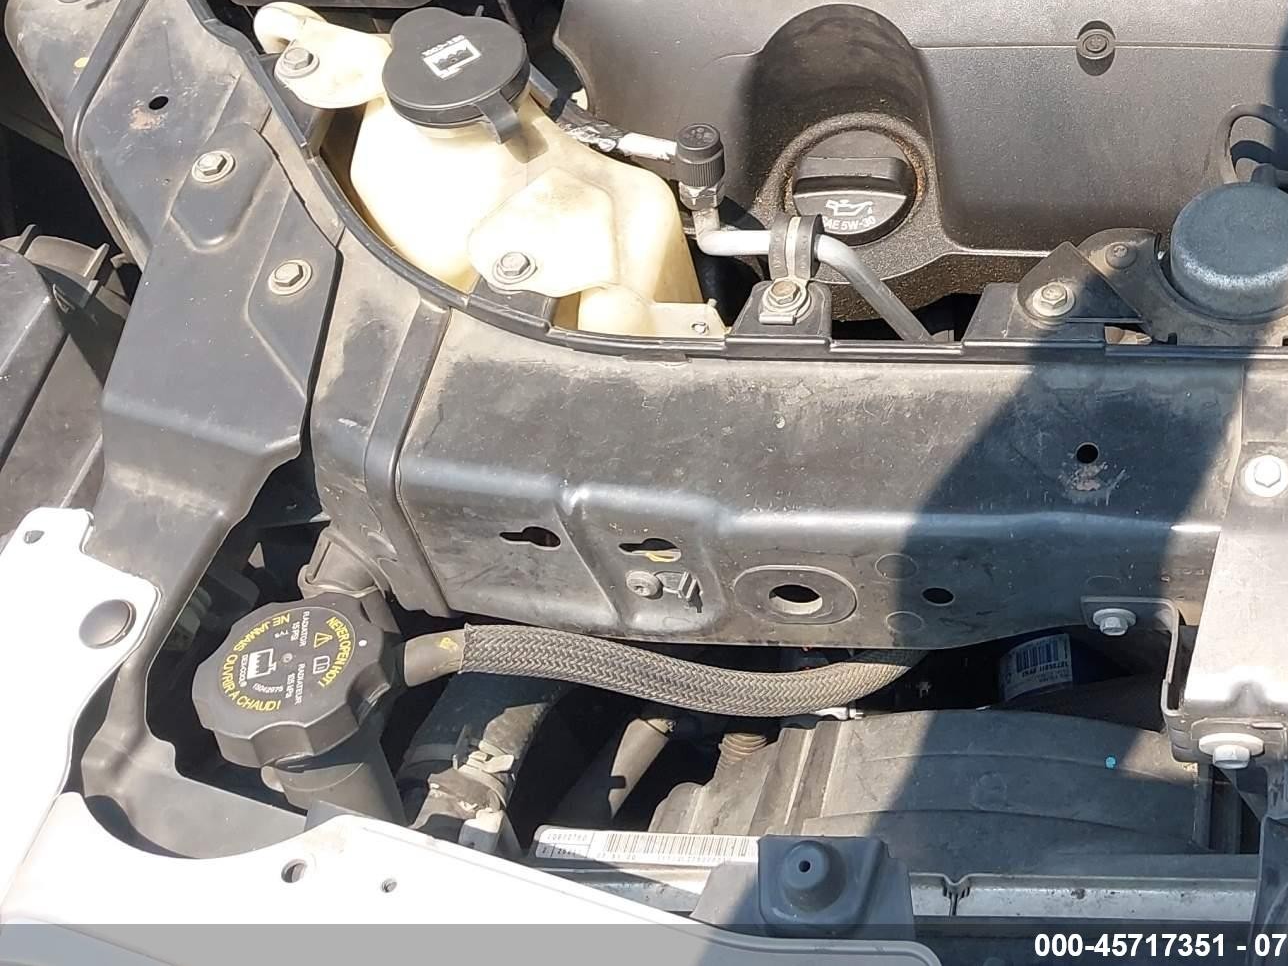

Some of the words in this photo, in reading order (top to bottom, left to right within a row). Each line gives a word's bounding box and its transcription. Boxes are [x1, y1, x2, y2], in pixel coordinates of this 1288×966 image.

[841, 216, 876, 230] 5W-30
[272, 613, 291, 627] NE
[299, 610, 310, 647] RADIATOR
[326, 616, 351, 641] NEVER
[233, 621, 273, 652] JAMAIS
[336, 640, 352, 666] OPEN
[221, 654, 239, 694] OUVRIR
[294, 663, 306, 705] RADIATEUR
[317, 665, 343, 688] HOT!
[236, 694, 282, 712] CHAUD!
